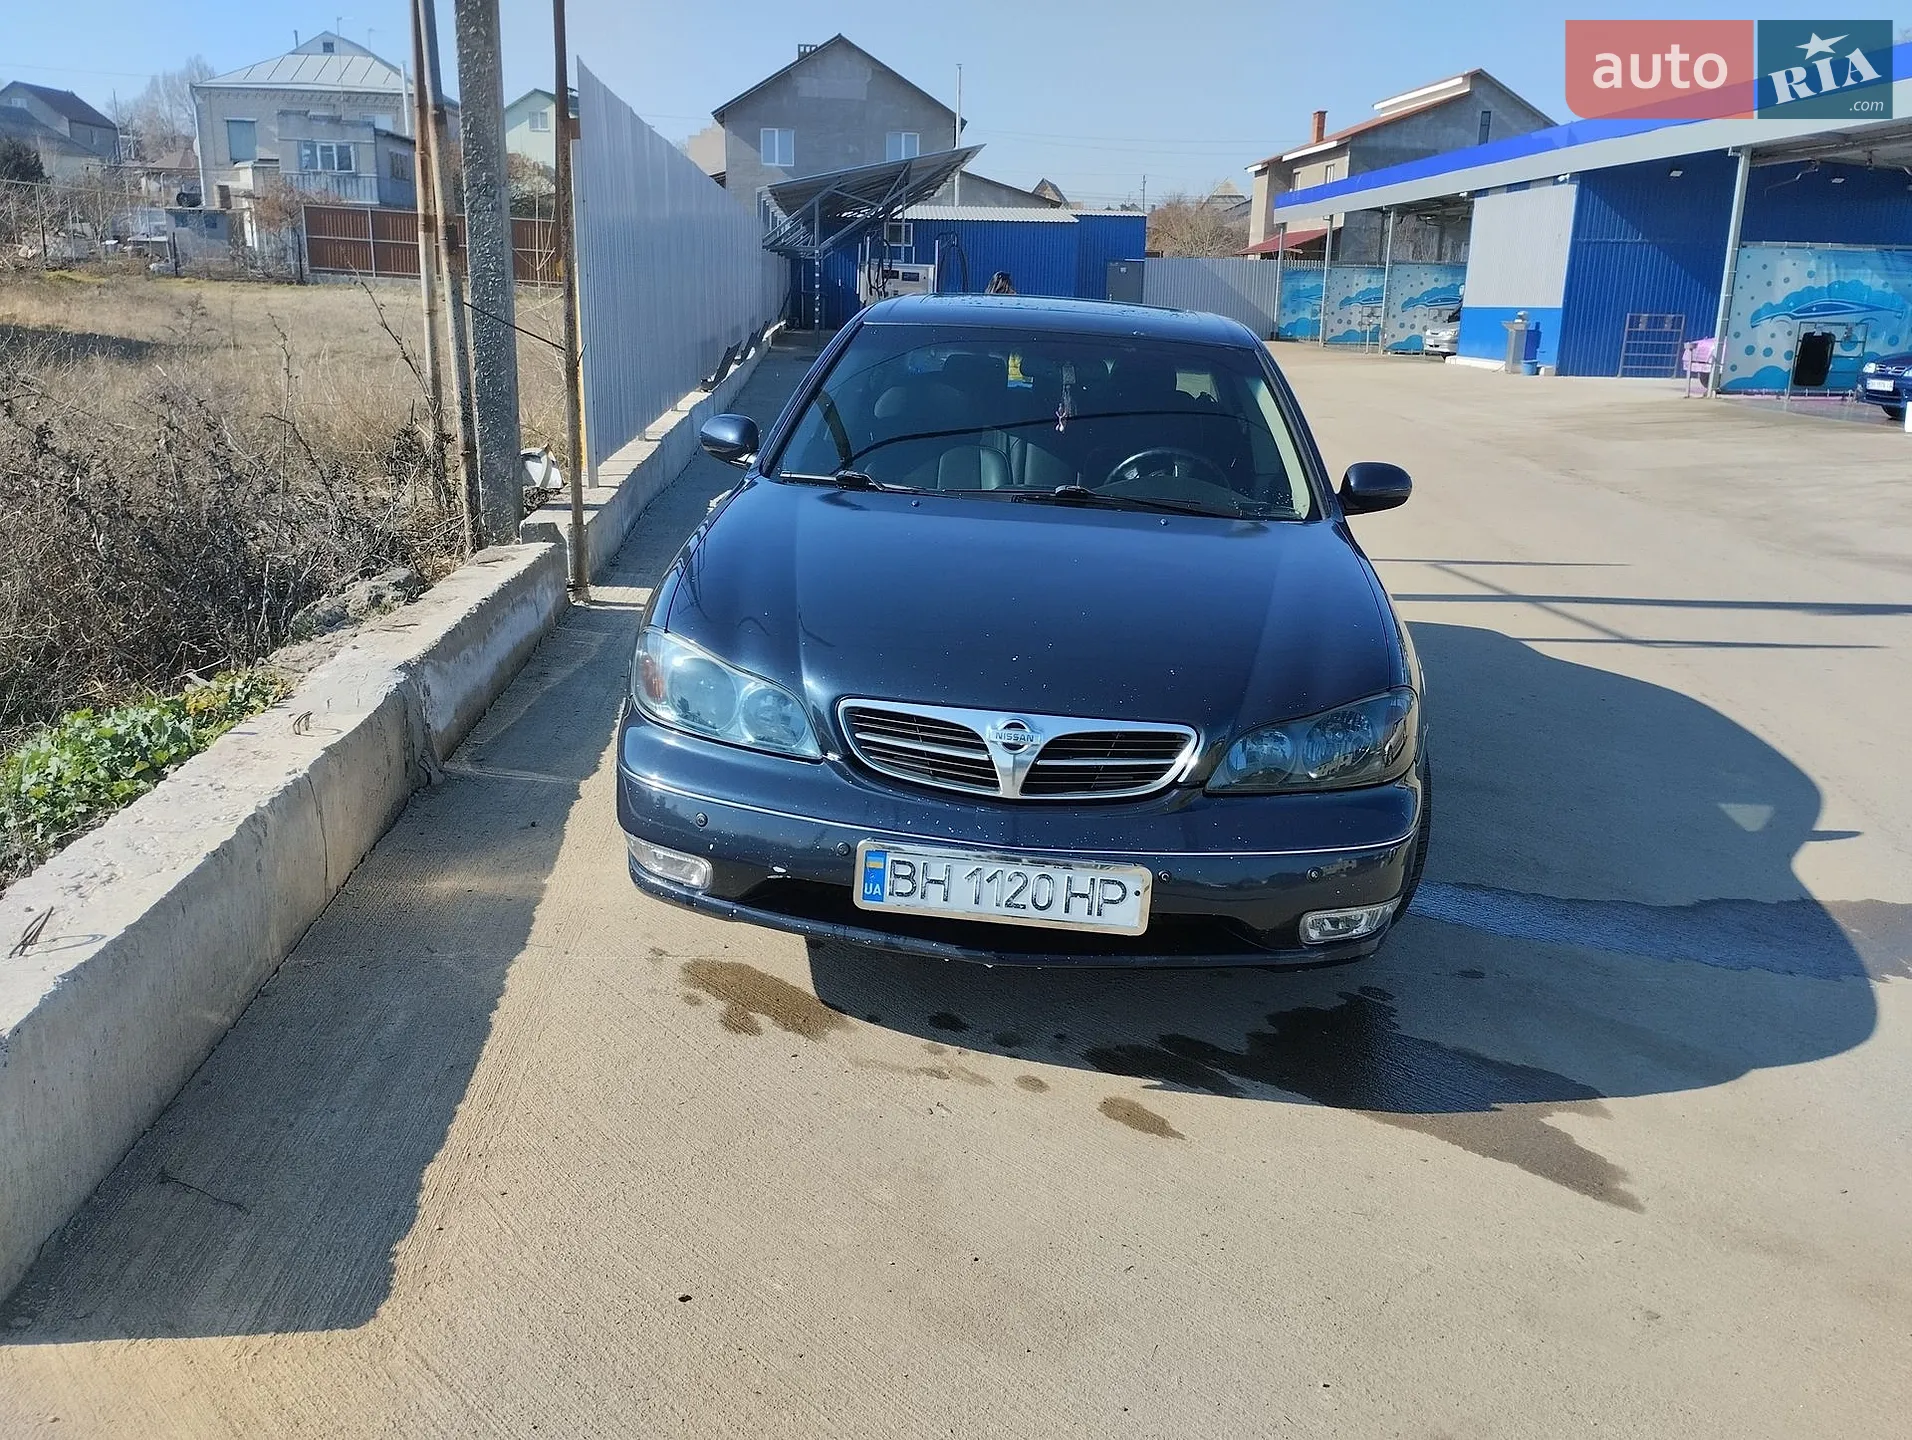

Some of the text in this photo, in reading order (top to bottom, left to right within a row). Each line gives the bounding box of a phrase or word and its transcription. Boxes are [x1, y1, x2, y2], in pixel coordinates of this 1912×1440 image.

[995, 732, 1034, 742] NISSAN
[864, 883, 882, 897] UA
[888, 859, 1128, 917] BH 1120 HP
